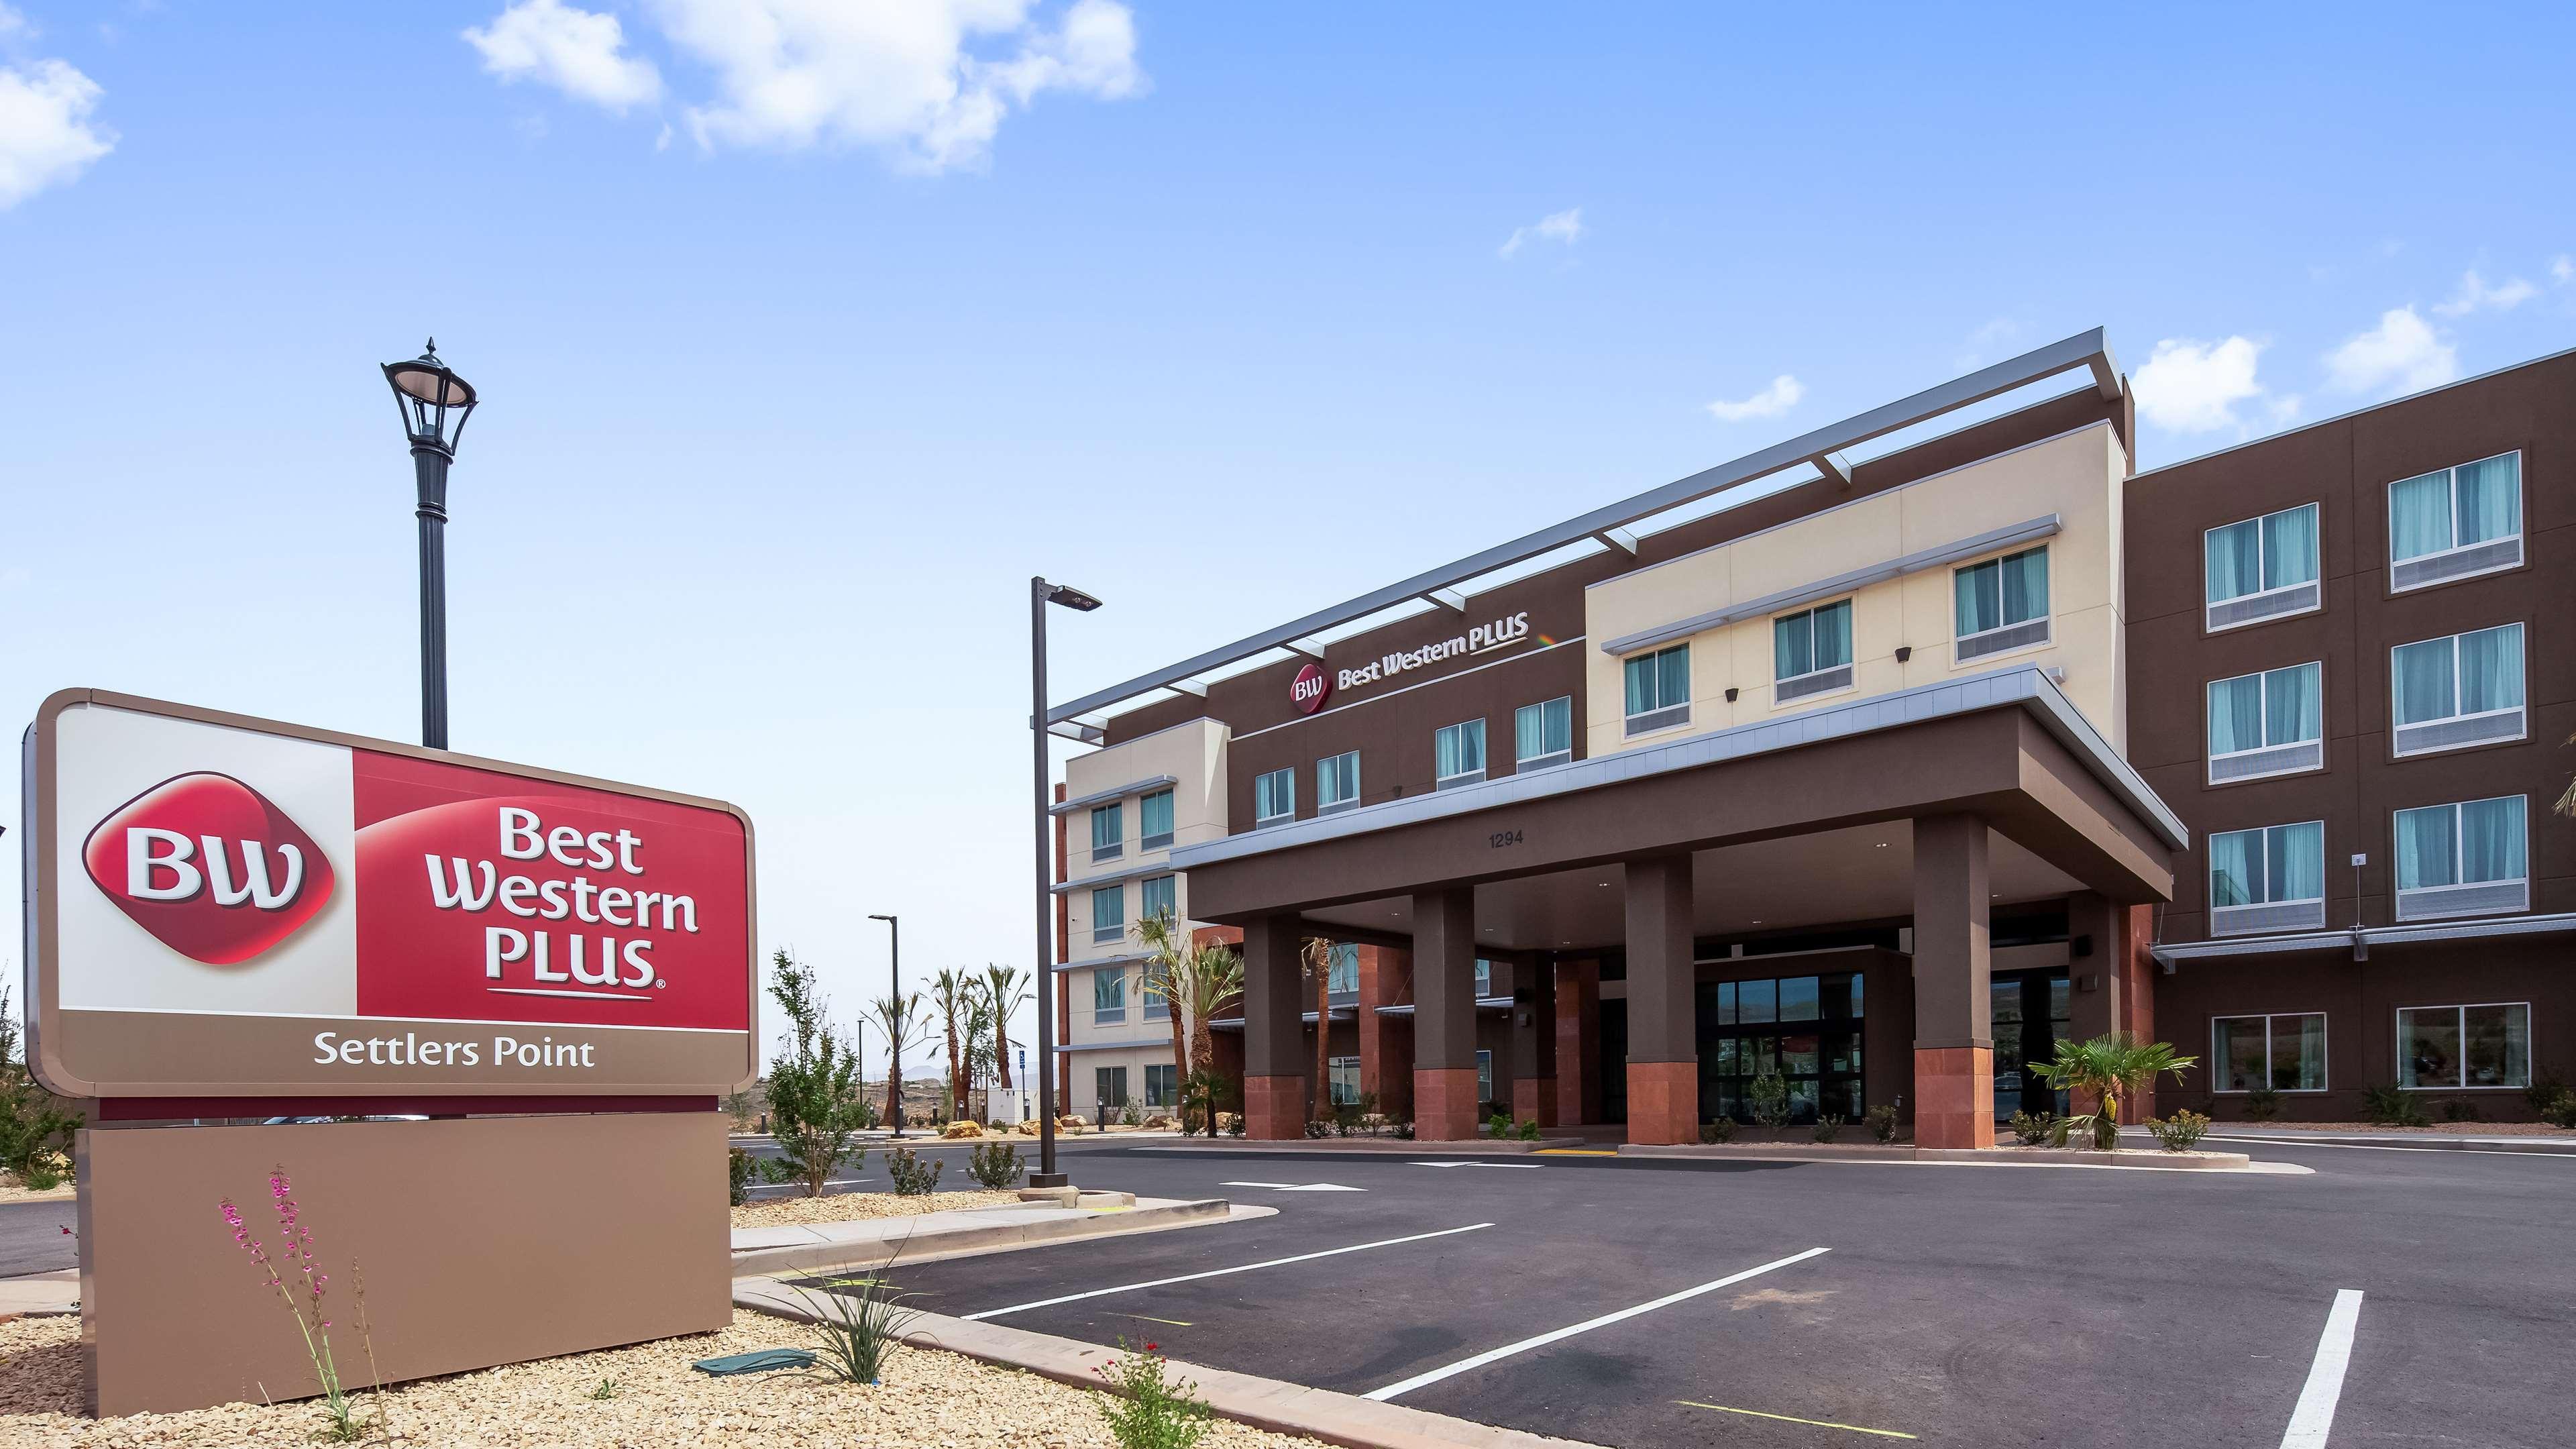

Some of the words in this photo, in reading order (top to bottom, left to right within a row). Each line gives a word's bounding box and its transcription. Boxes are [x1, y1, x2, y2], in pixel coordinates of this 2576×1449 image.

[1338, 661, 1382, 690] Best
[1382, 637, 1467, 676] Western
[1469, 612, 1529, 651] PLUS
[1295, 676, 1322, 701] BW
[127, 827, 303, 909] BW
[499, 806, 644, 875] Best
[1489, 830, 1523, 848] 1294
[425, 853, 699, 932] Western
[314, 1032, 480, 1066] Settlers
[494, 1036, 595, 1067] Point
